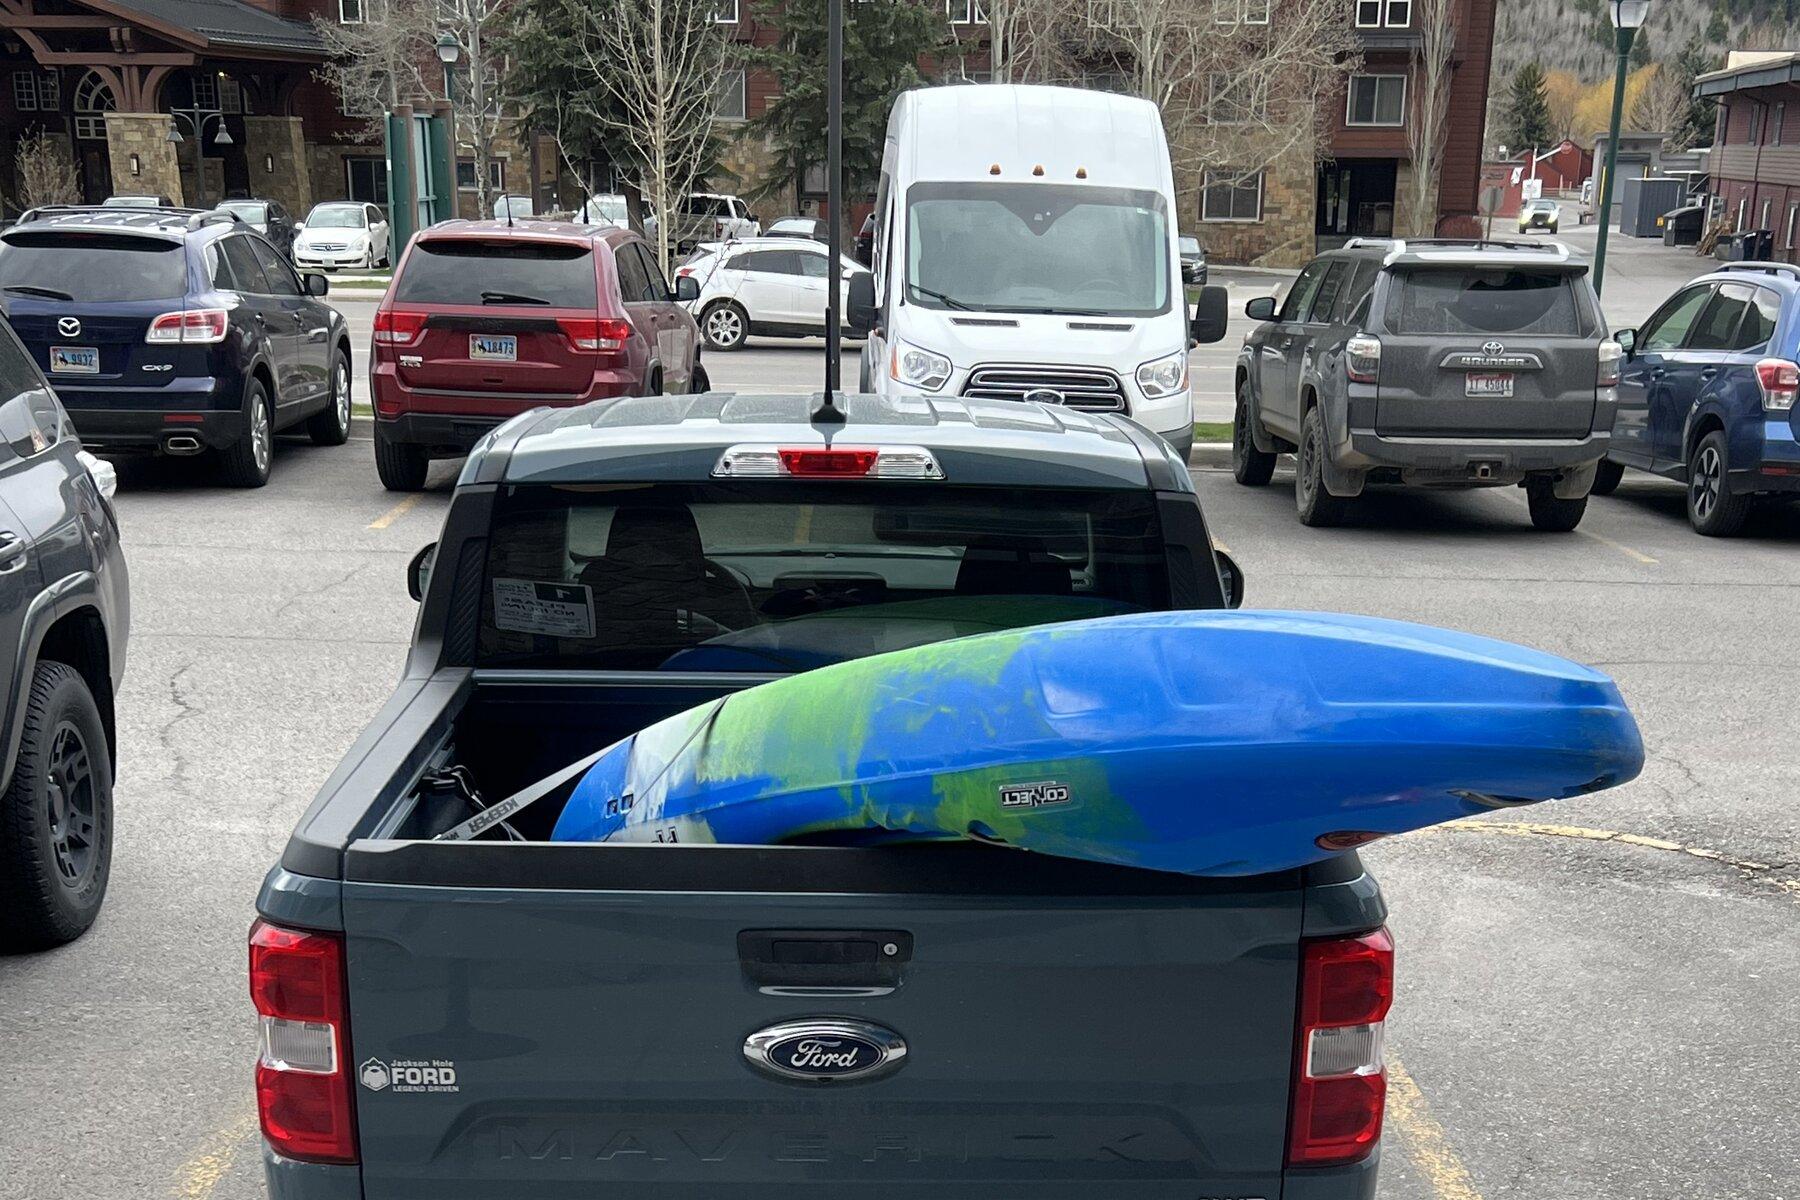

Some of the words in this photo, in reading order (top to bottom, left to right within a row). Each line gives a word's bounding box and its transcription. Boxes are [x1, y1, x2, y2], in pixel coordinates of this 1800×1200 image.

[1002, 785, 1067, 807] CONNECT
[468, 798, 520, 833] KEEPER
[790, 1039, 859, 1068] Ford
[391, 1067, 456, 1085] FORD
